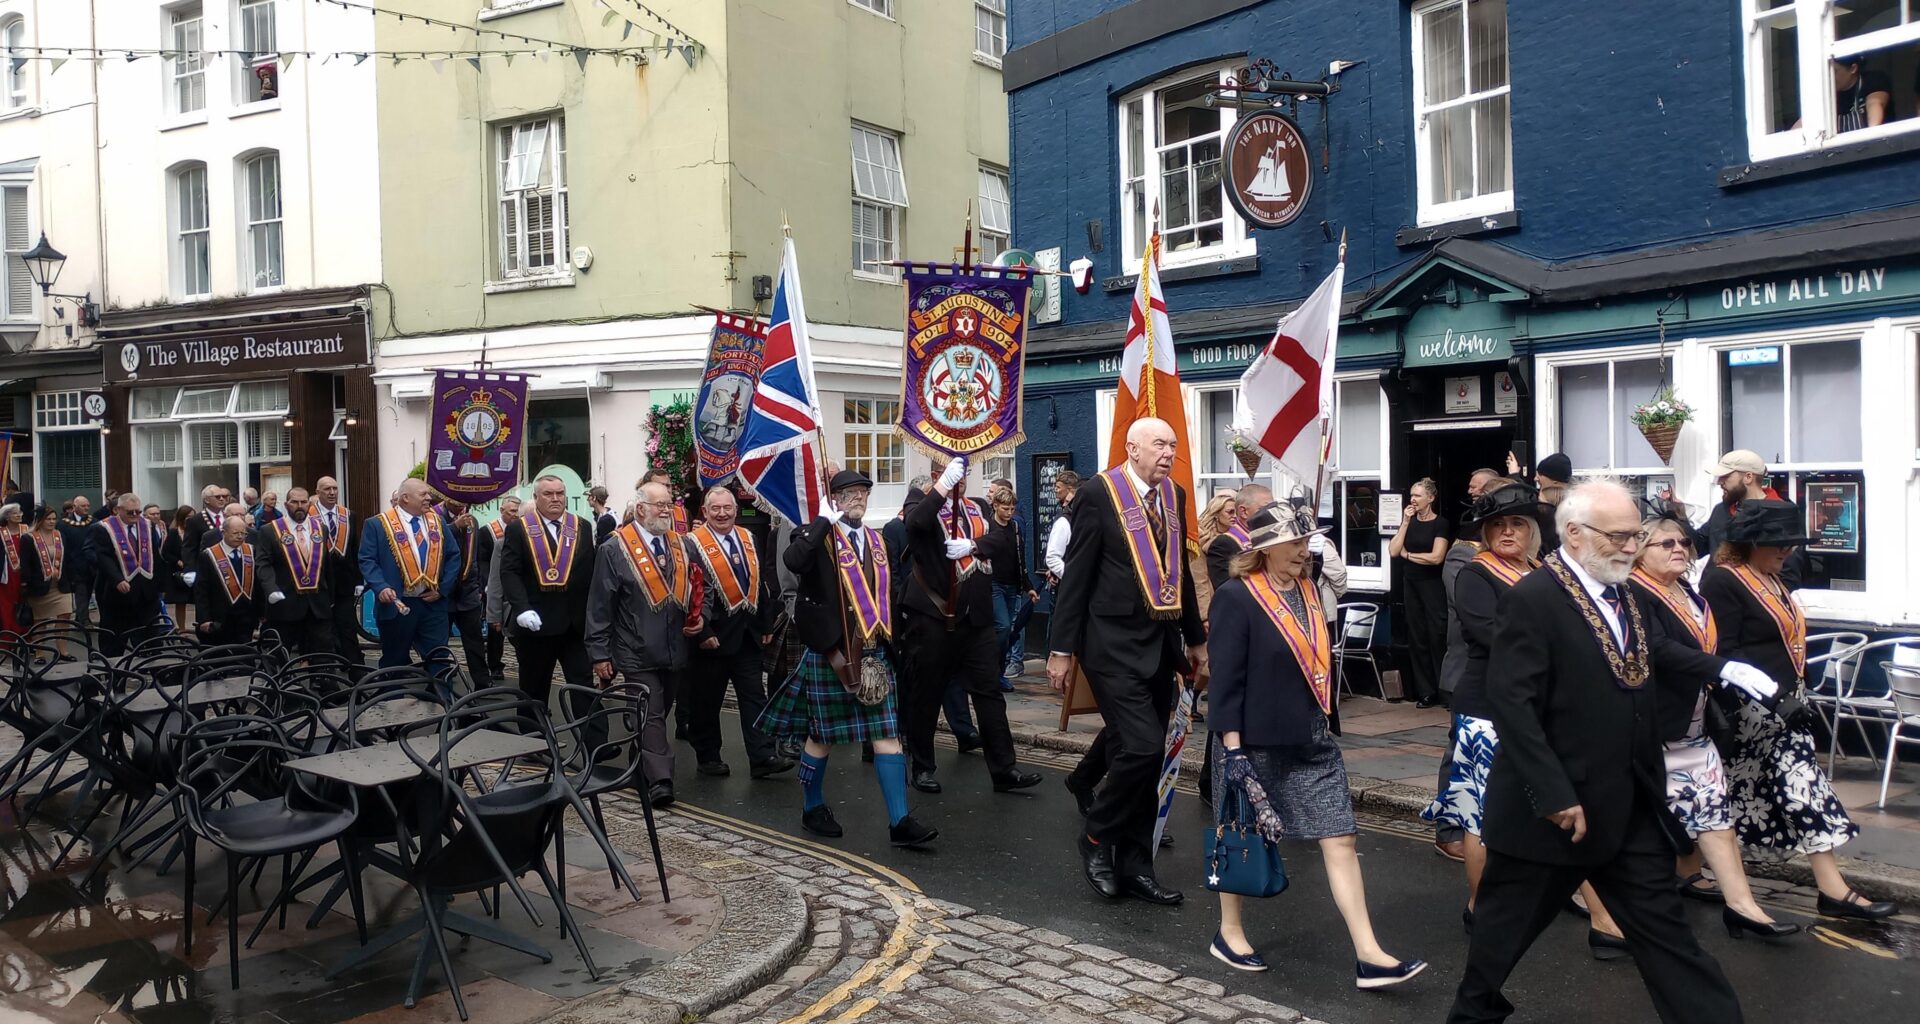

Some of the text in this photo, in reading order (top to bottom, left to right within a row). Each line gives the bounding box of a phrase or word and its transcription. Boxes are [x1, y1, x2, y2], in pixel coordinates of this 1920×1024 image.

[1239, 119, 1298, 148] THE NAVY INN
[1721, 267, 1885, 310] OPEN ALL DAY
[146, 332, 344, 367] The Village Restaurant
[986, 326, 1015, 350] 904
[1419, 328, 1498, 358] welcome
[1099, 357, 1123, 373] REAL
[1192, 343, 1256, 364] GOOD FOOD
[924, 426, 995, 451] PLYMOUTH
